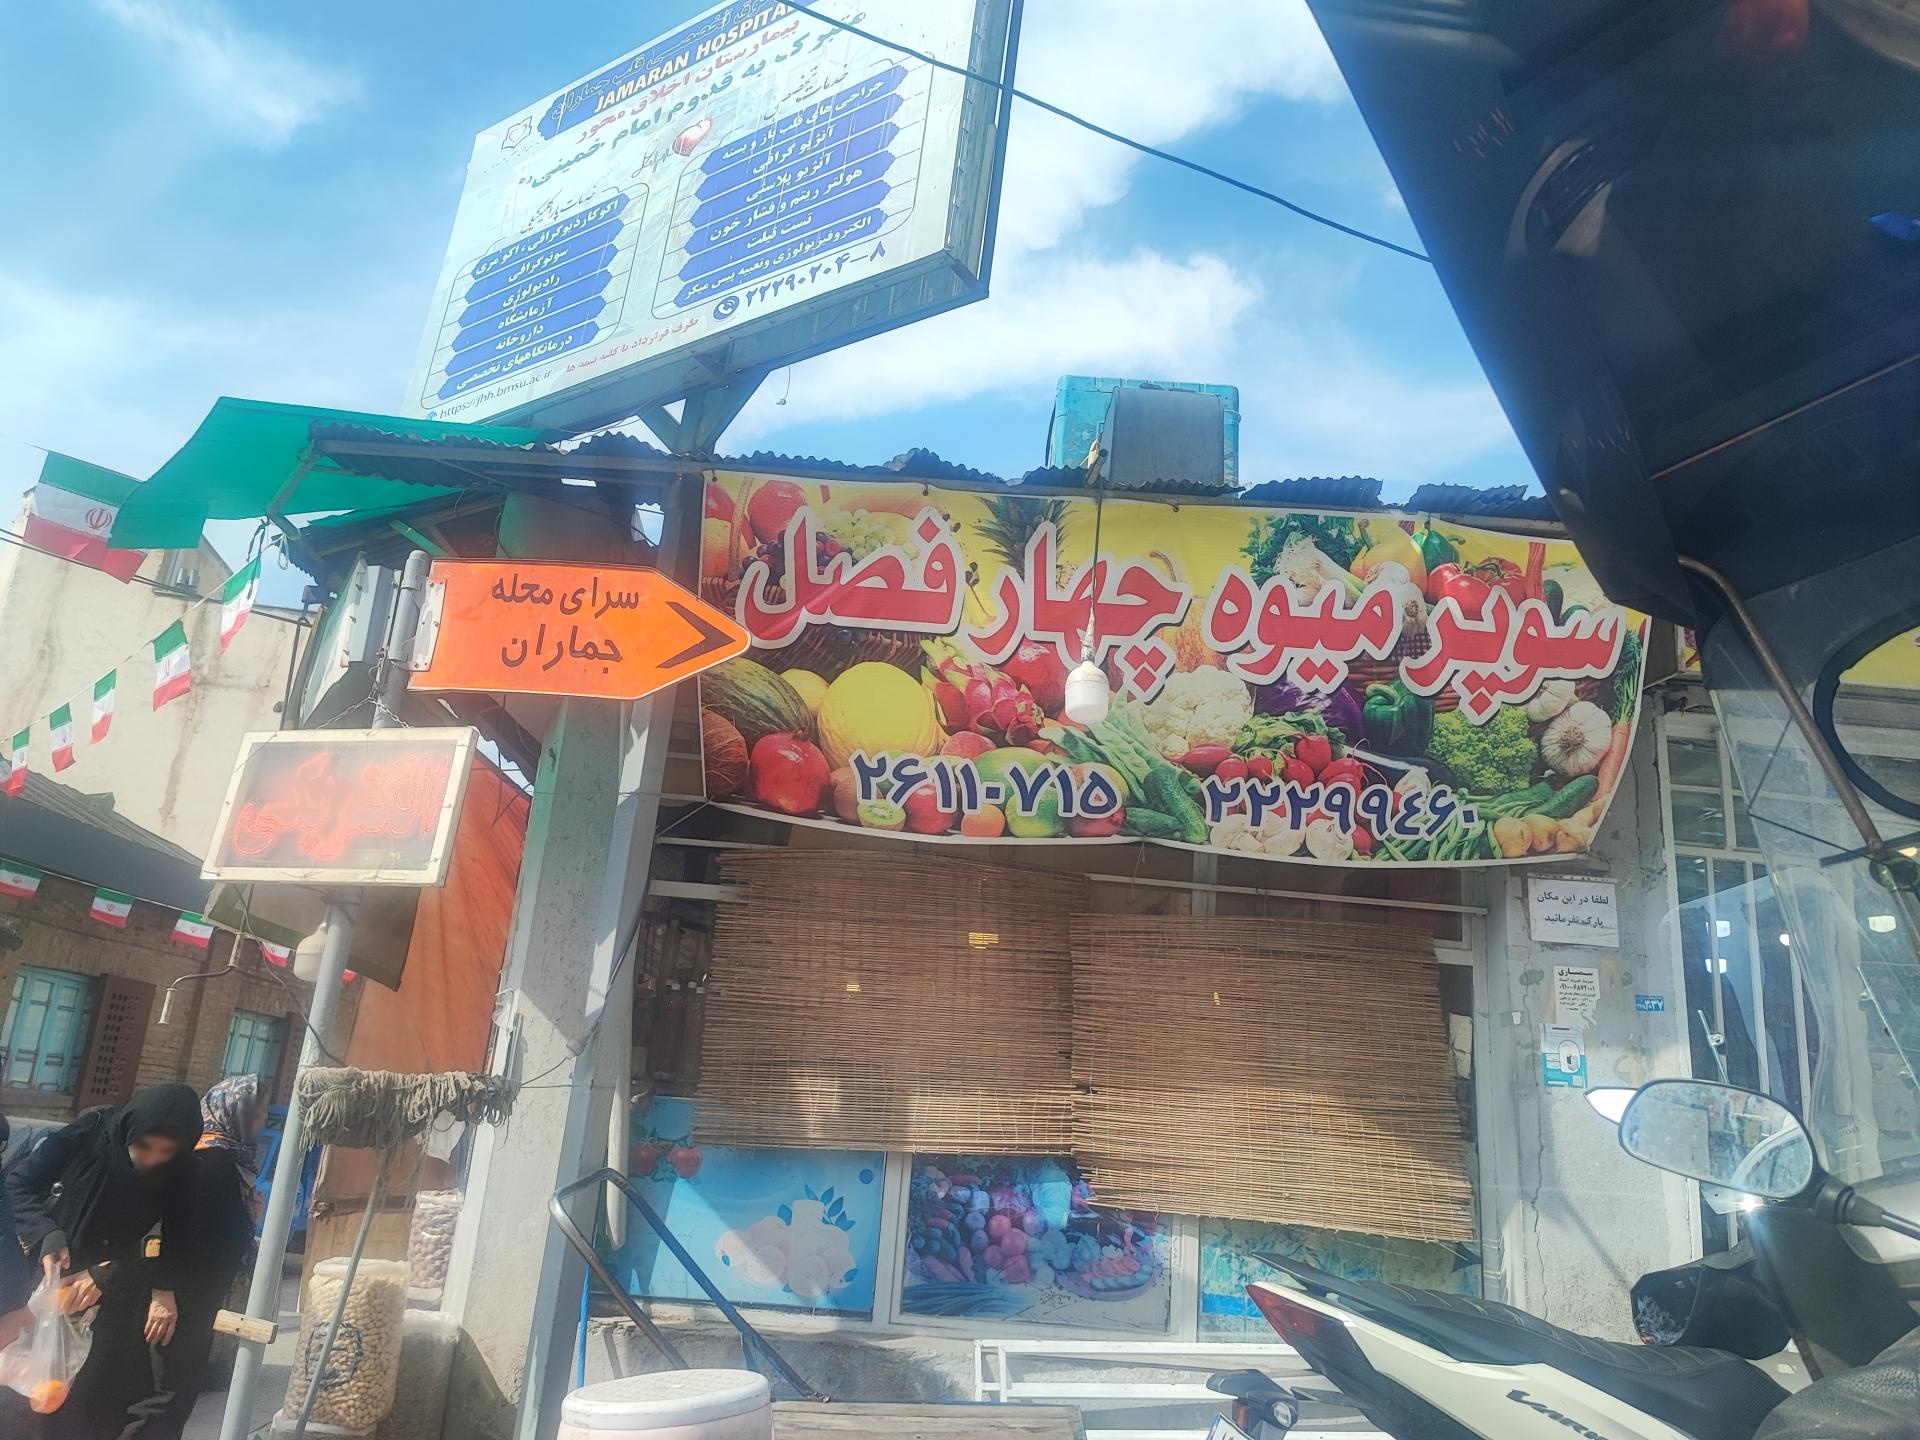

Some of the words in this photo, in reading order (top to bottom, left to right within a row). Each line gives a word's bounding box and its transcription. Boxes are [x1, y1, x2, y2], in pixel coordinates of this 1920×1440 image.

[695, 19, 801, 84] بیمارستان
[594, 51, 690, 113] JAMARAN
[741, 57, 767, 80] به
[632, 70, 691, 116] اخلاق
[667, 70, 733, 122] قدوم
[835, 81, 885, 111] جراحی
[576, 110, 626, 145] محور
[611, 107, 662, 150] امام
[780, 113, 803, 134] قلب
[806, 102, 834, 124] های
[761, 126, 776, 145] باز
[531, 137, 606, 188] خمینی
[722, 144, 747, 160] بسته
[746, 170, 792, 202] پلاستی
[824, 168, 863, 193] هولتر
[790, 188, 820, 209] ریتم
[709, 218, 741, 241] خون
[745, 202, 776, 227] فشار
[780, 213, 813, 234] تست
[501, 244, 519, 264] اکو
[502, 273, 561, 308] رادیولوژی
[495, 323, 544, 351] داروخانه
[491, 573, 554, 606] محله
[738, 509, 962, 646] فصل
[559, 576, 640, 619] سرای
[966, 526, 1187, 695] چهار
[1206, 569, 1399, 689] میوه
[501, 623, 624, 674] جماران
[1402, 589, 1621, 720] سوپر
[851, 753, 1121, 815] ۲۶۱۱۰۷۱۵
[1537, 891, 1559, 902] مکان
[1562, 893, 1576, 904] این
[1579, 896, 1588, 905] در
[1591, 894, 1609, 905] لطفا
